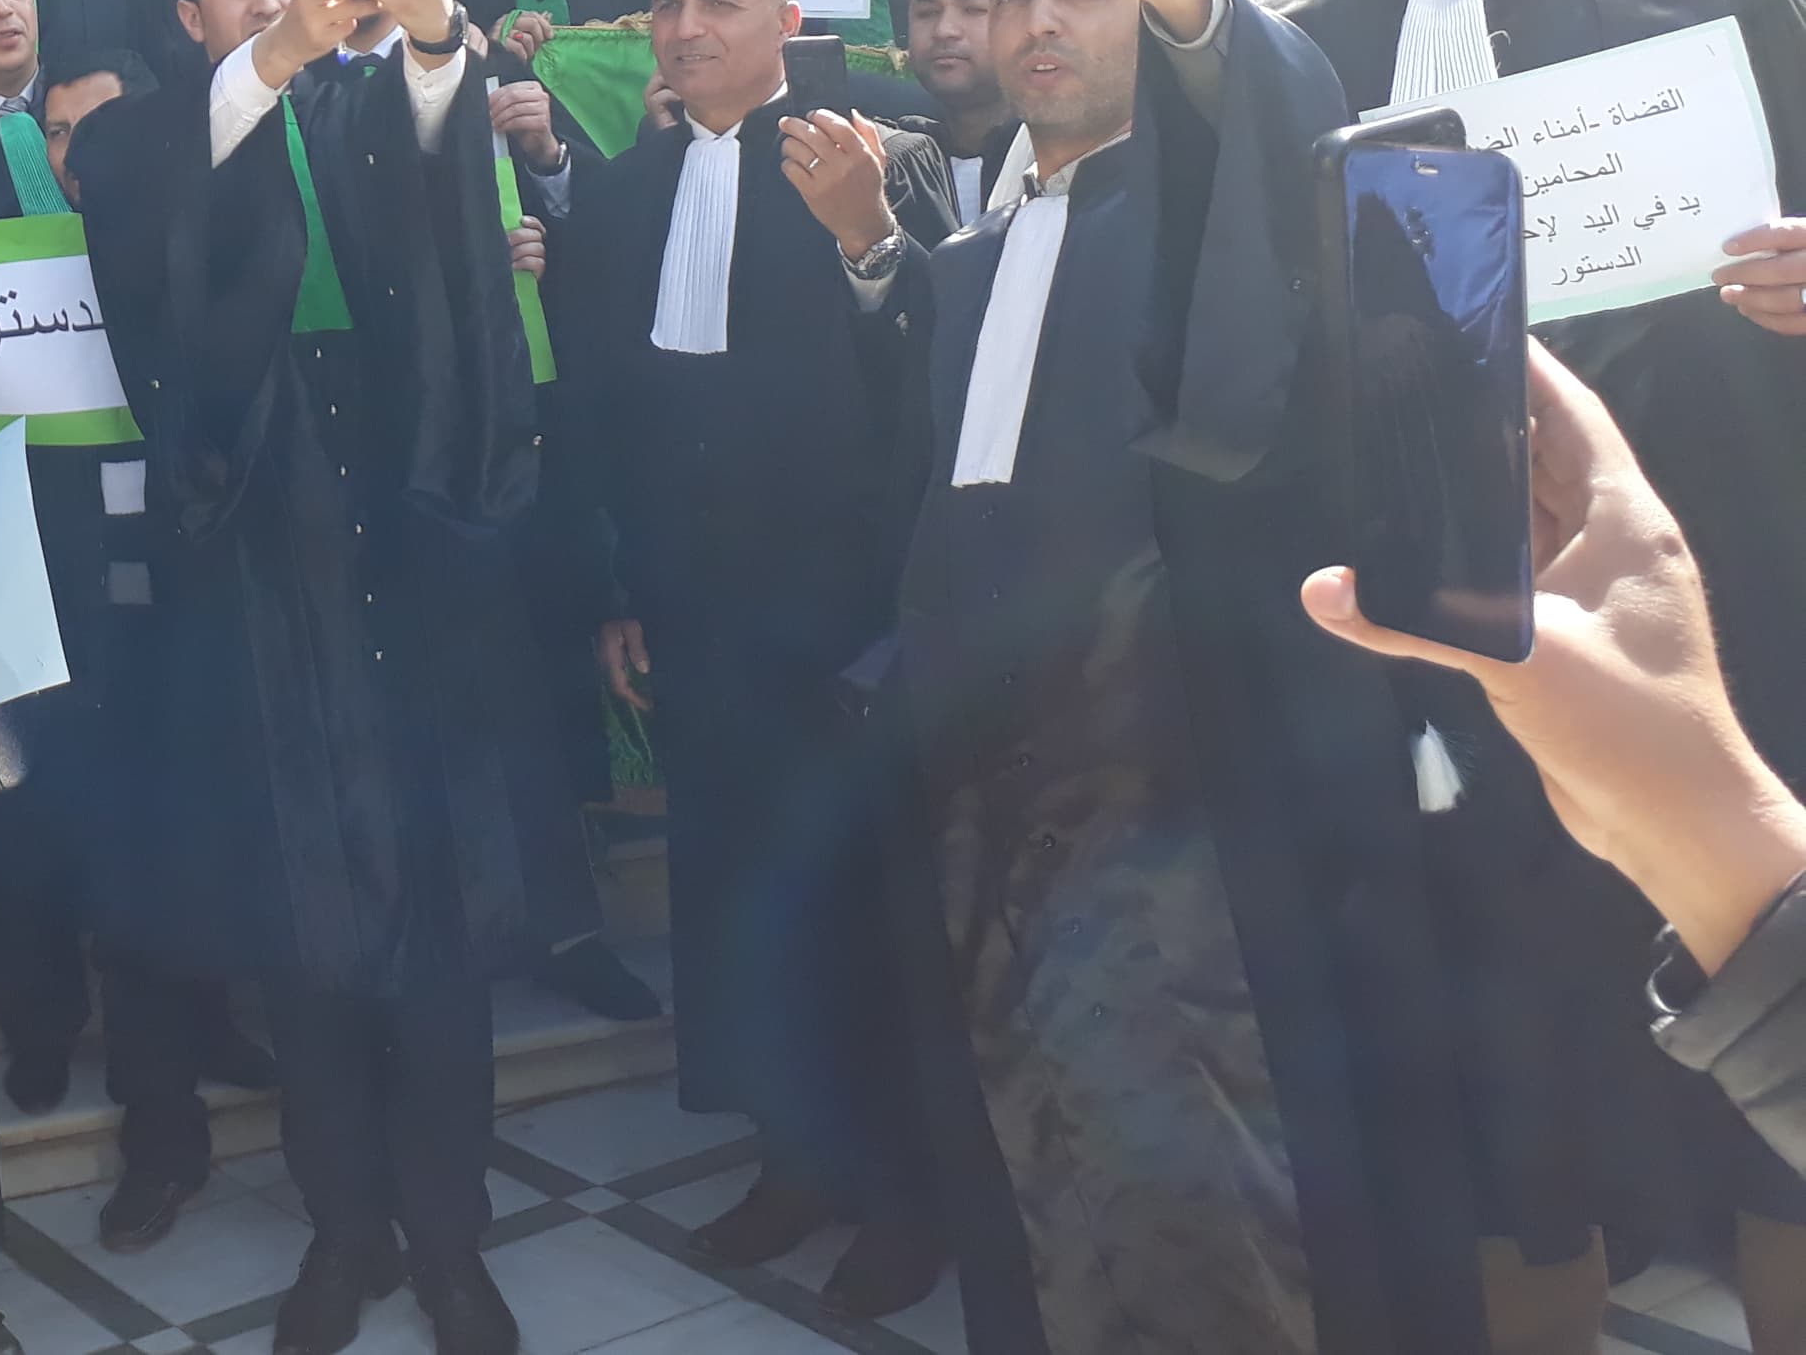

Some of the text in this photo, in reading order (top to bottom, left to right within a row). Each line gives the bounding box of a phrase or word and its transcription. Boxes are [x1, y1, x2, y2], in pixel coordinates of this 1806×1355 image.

[1608, 87, 1685, 127] القضاة
[1522, 152, 1623, 198] المحامين
[1583, 203, 1621, 234] اليد
[1633, 196, 1667, 231] في
[1677, 193, 1701, 220] يد
[1551, 245, 1643, 286] الدستور
